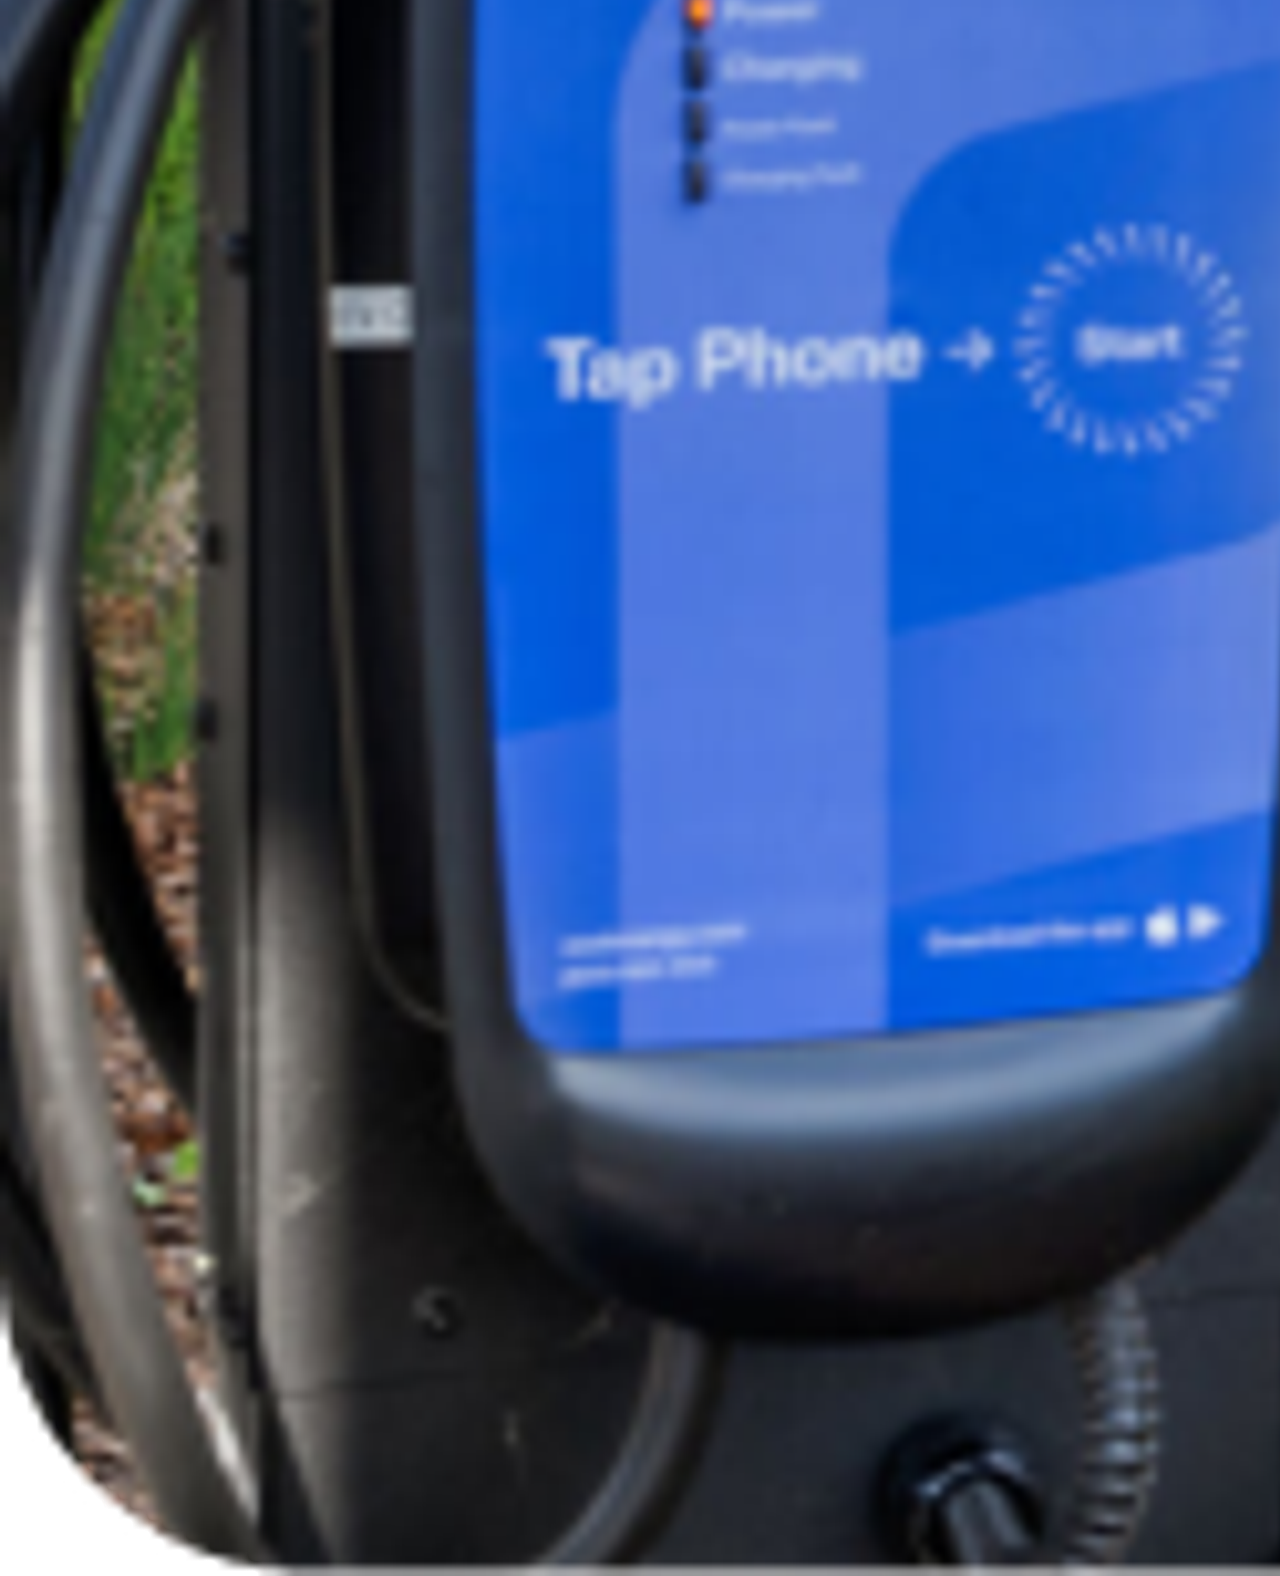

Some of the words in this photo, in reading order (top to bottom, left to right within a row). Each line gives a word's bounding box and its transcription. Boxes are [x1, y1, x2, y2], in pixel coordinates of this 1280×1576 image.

[545, 335, 679, 410] Tap
[696, 324, 924, 393] Phone
[1074, 322, 1184, 368] Start
